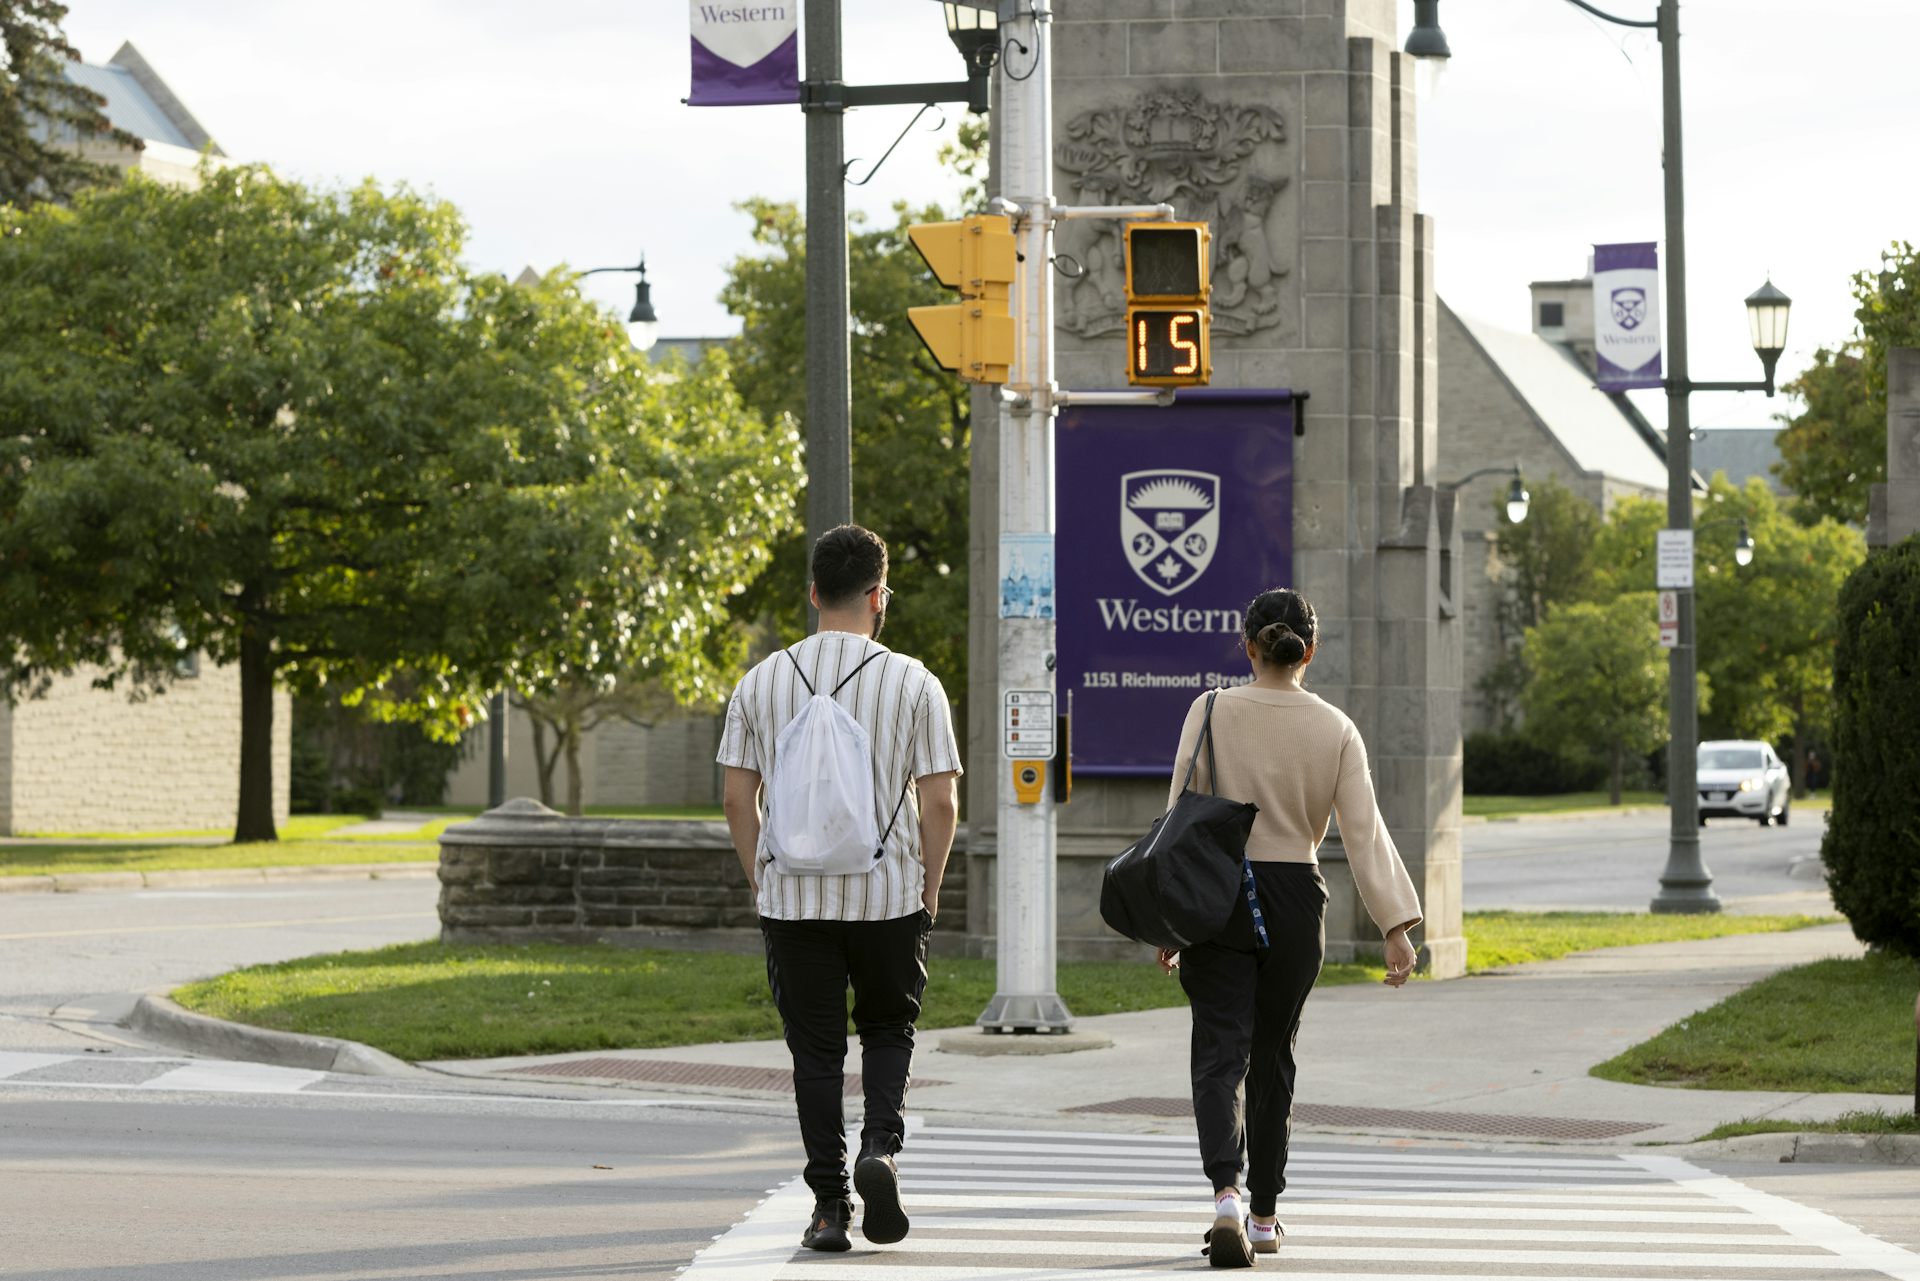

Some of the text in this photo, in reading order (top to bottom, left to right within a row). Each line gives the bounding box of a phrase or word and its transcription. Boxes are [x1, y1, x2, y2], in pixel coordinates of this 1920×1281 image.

[700, 5, 785, 23] Western
[1138, 315, 1197, 374] 15
[1097, 599, 1244, 633] Western
[1083, 672, 1256, 688] 1151 Richmond Street
